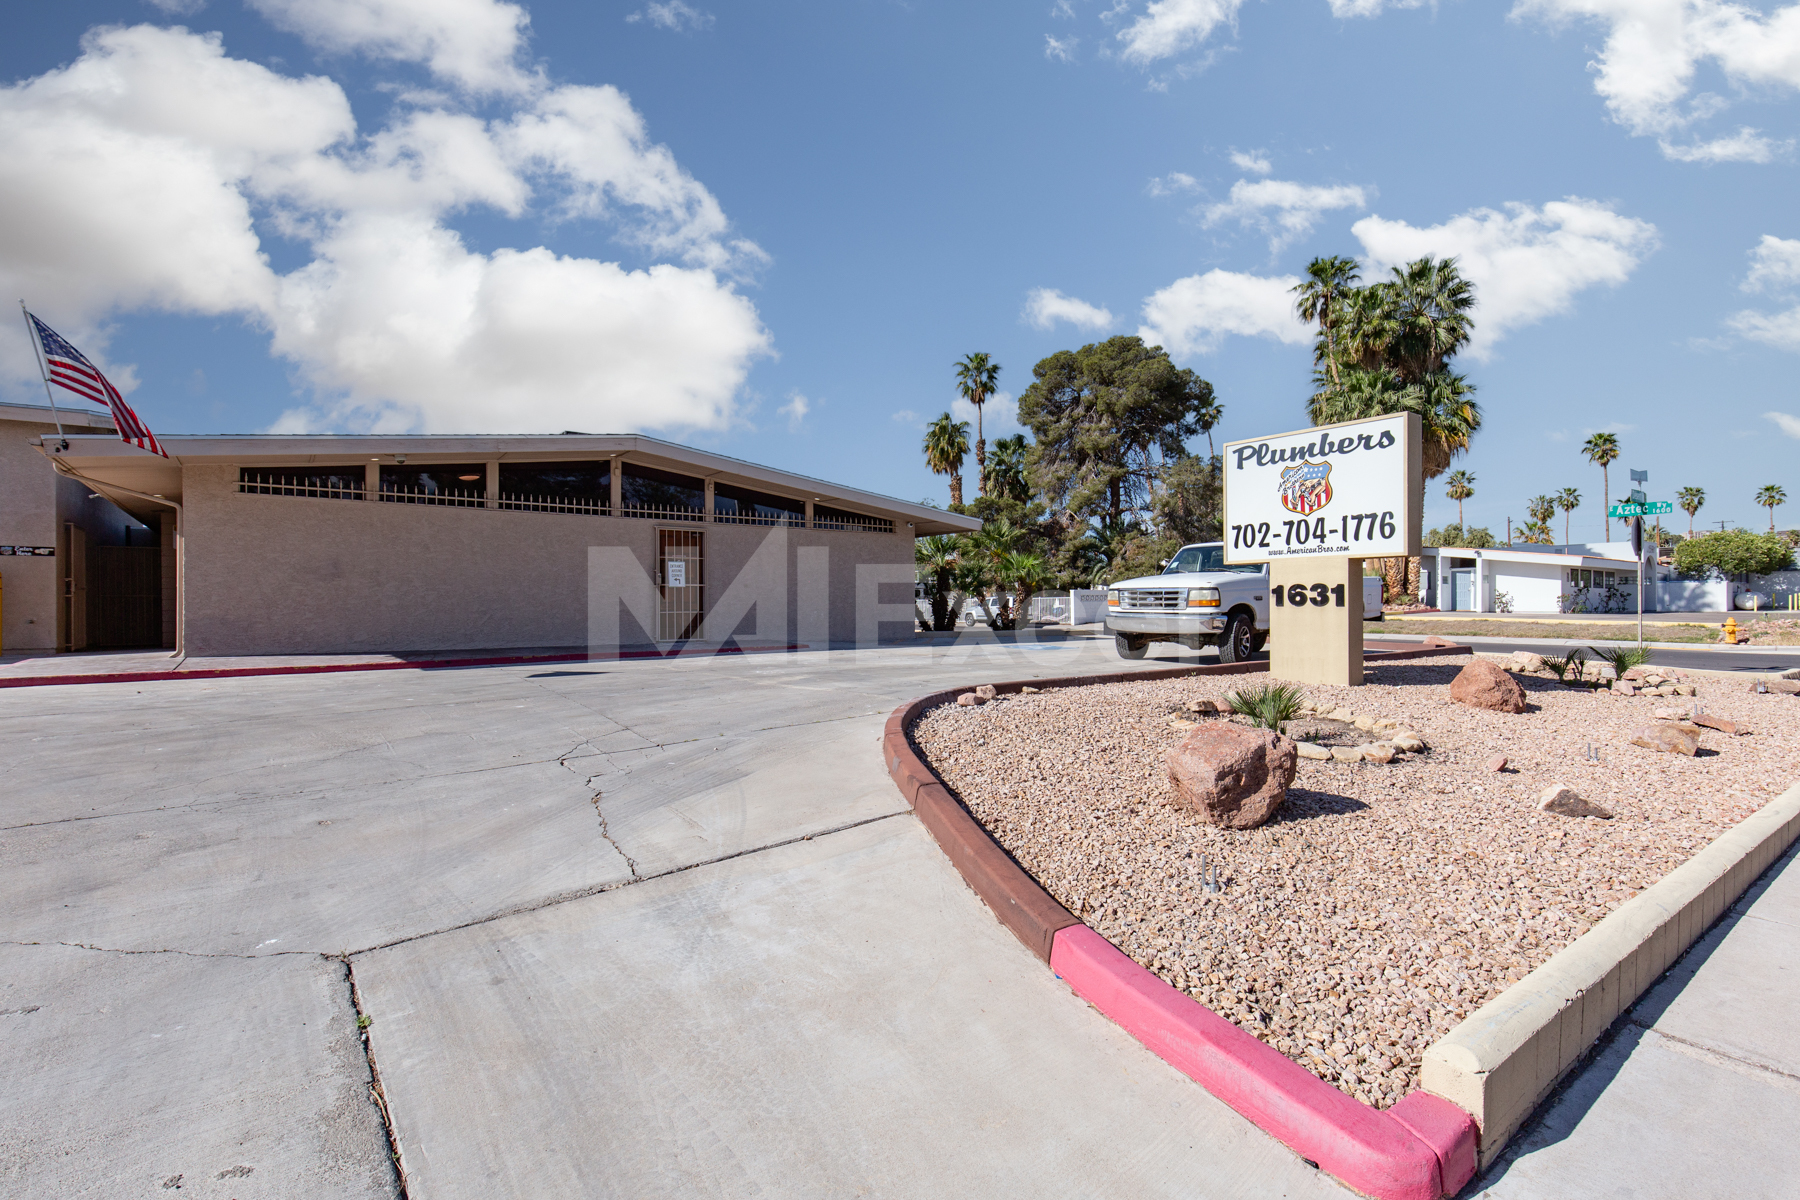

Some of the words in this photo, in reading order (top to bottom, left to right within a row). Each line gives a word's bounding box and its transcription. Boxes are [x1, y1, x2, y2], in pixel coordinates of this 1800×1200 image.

[1232, 430, 1396, 470] Plumbers
[1616, 504, 1649, 516] Aztec
[1232, 511, 1396, 549] 702-704-1776
[1268, 544, 1350, 556] www.AmericanBros.com
[1271, 583, 1345, 607] 1631
